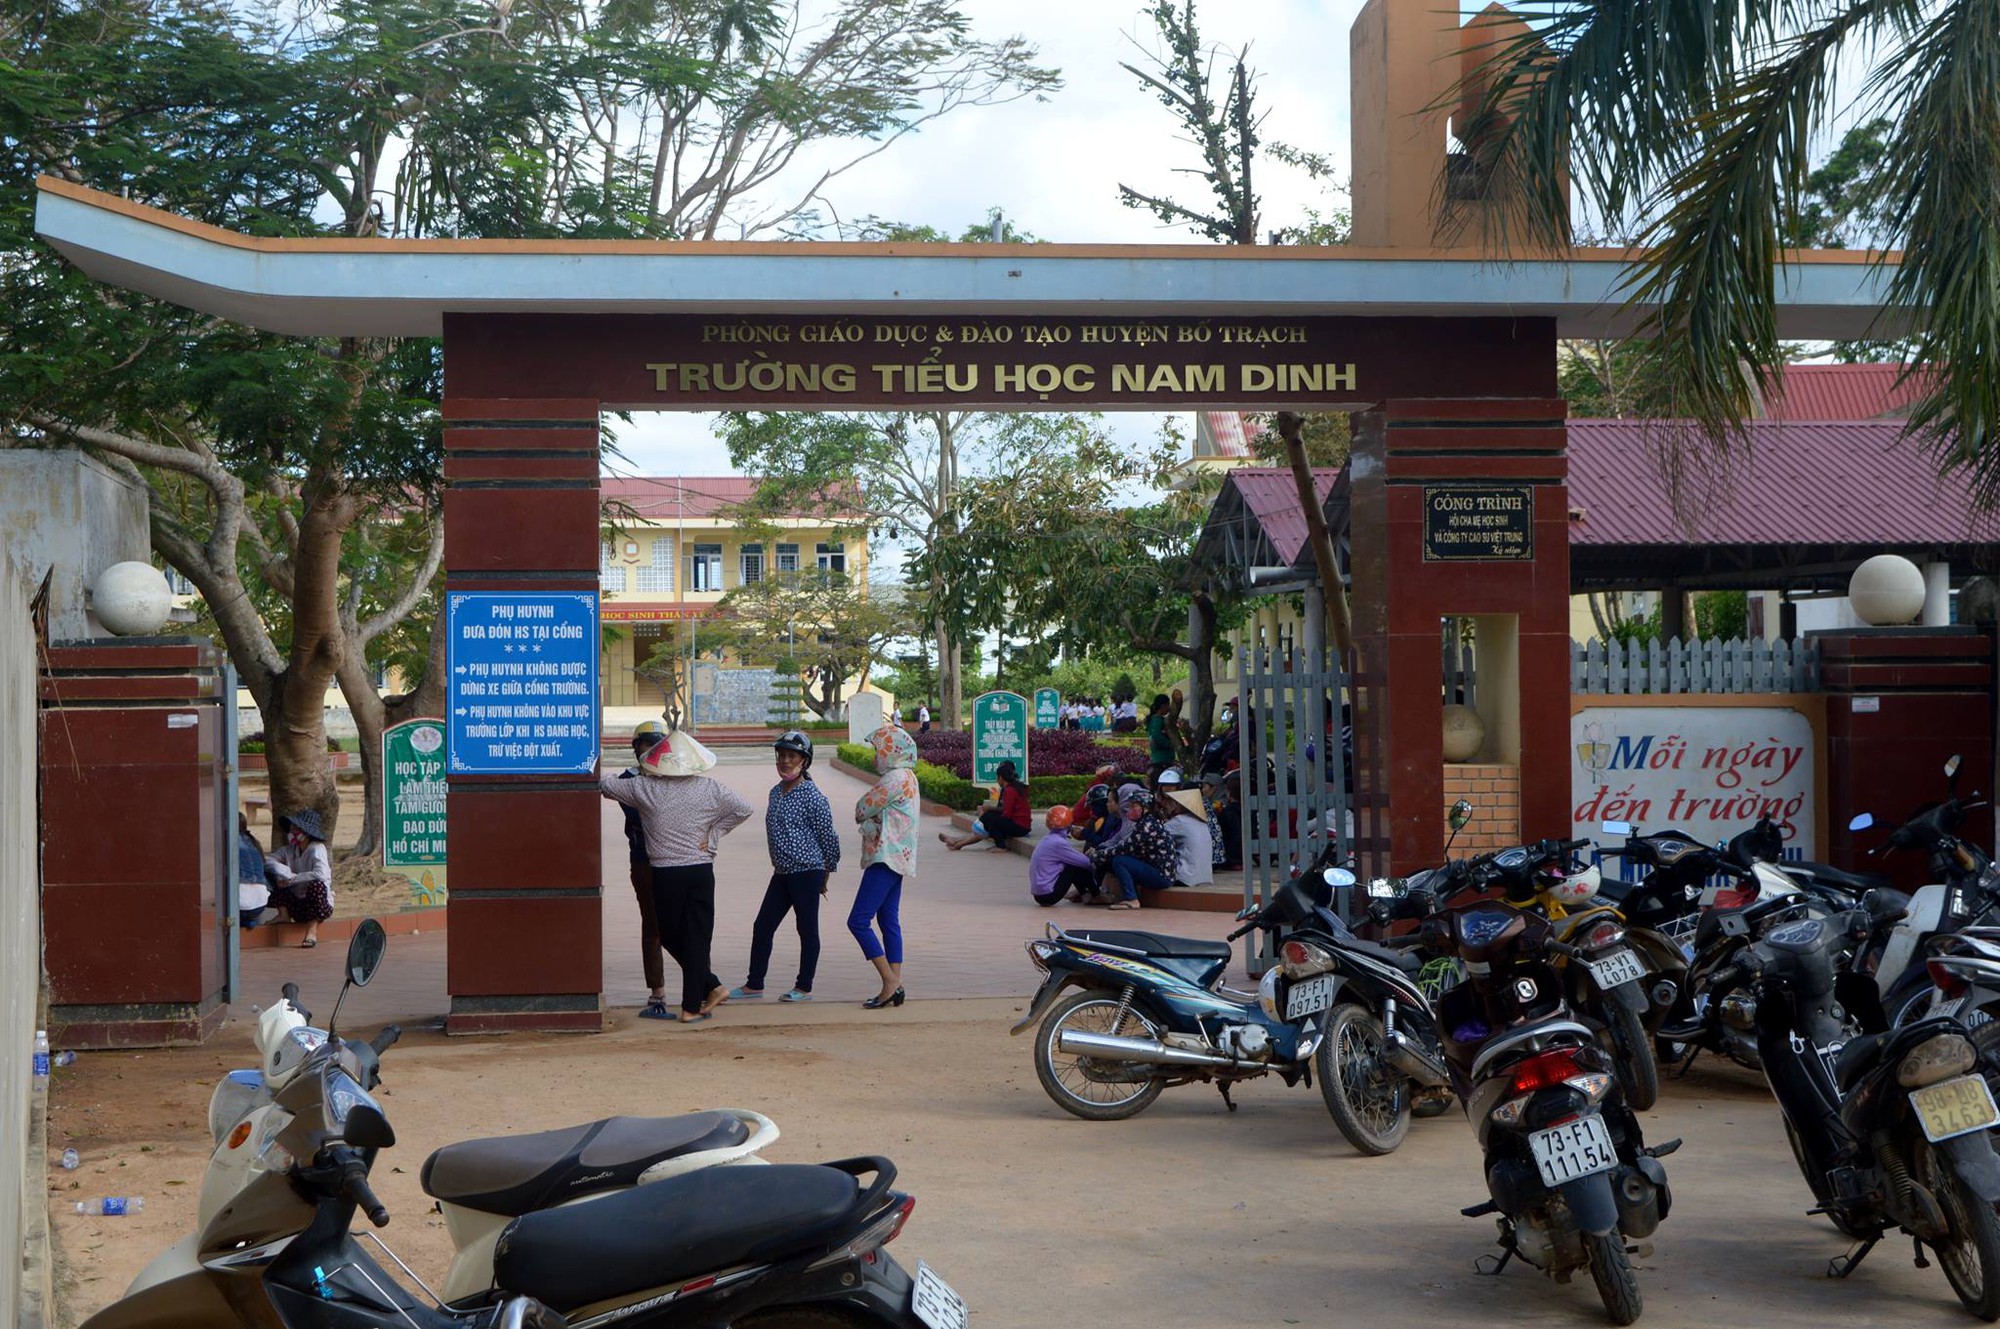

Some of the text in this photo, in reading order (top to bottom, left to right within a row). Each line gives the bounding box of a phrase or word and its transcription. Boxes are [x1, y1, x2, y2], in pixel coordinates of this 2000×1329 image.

[701, 318, 1307, 348] PHÒNG GIÁO DỤC & ĐÀO TẠO HUYỆN BỐ TRẠCH
[646, 346, 1356, 400] TRƯỜNG TIỂU HỌC NAM DINH
[1434, 493, 1523, 511] CÔNG TRÌNH
[492, 605, 554, 621] PHỤ HUYNH
[628, 611, 655, 620] SINH
[463, 621, 583, 641] ĐƯA ĐÓN HS TẠI CỔNG
[470, 660, 587, 678] PHỤ HUYNH KHÔNG ĐƯỢC
[487, 683, 499, 695] XE
[470, 703, 590, 720] PHỤ HUYNH KHÔNG VÀO KHU VỰC
[466, 721, 497, 738] TRƯỜNG
[499, 721, 514, 738] LỚP
[516, 725, 530, 738] KHI
[534, 725, 545, 738] HS
[547, 725, 569, 738] ĐANG
[505, 742, 522, 759] VIỆC
[524, 742, 539, 759] ĐỘT
[395, 762, 418, 778] HỌC
[420, 759, 441, 777] TẬP
[1607, 734, 1804, 789] Mỗi ngày
[1573, 783, 1804, 841] đến trường
[403, 821, 425, 836] ĐẠO
[410, 837, 429, 853] CHÍ
[1603, 965, 1638, 985] 4078
[1295, 979, 1325, 1000] 73-F1
[1289, 993, 1328, 1017] 097.51
[1541, 1120, 1596, 1155] 73-F1
[1544, 1143, 1611, 1181] 111.54
